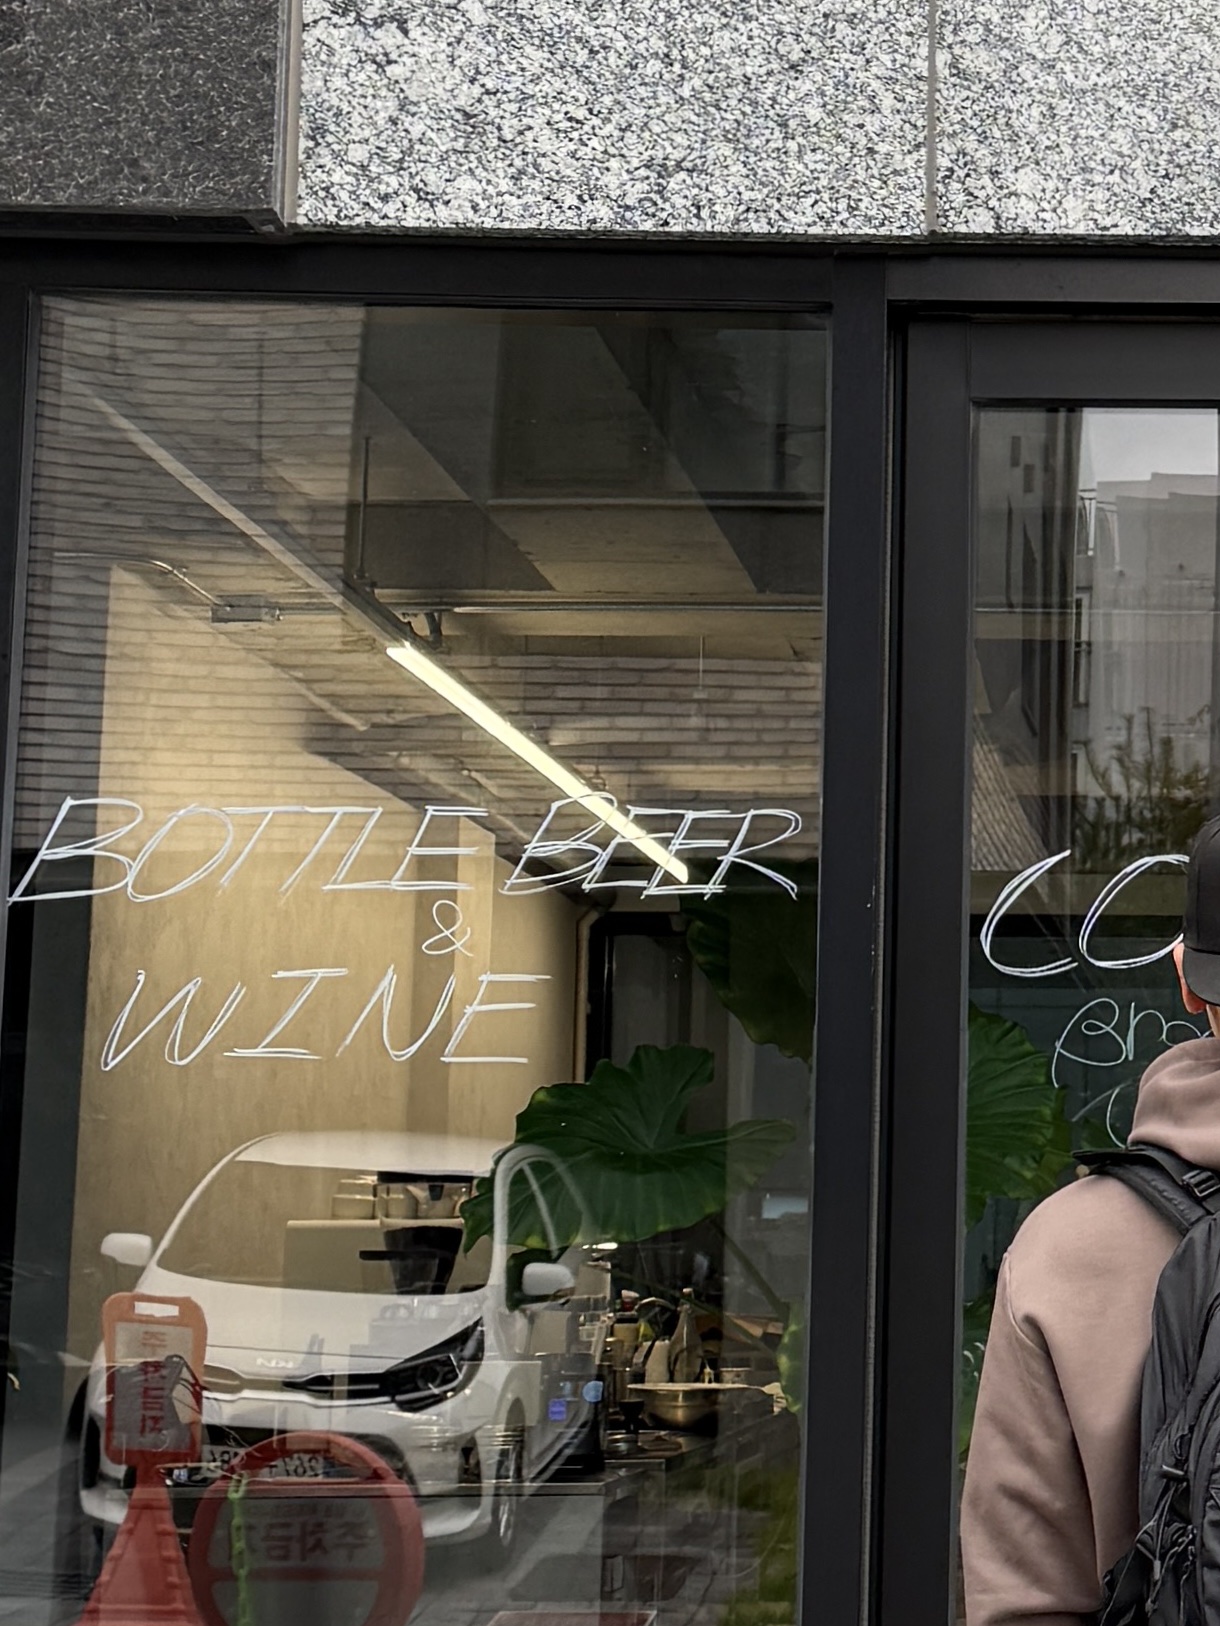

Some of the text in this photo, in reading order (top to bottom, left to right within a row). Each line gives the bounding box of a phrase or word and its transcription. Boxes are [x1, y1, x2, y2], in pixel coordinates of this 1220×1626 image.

[7, 791, 803, 904] BOTTLE BEER
[421, 899, 474, 957] &
[100, 963, 552, 1072] WINE
